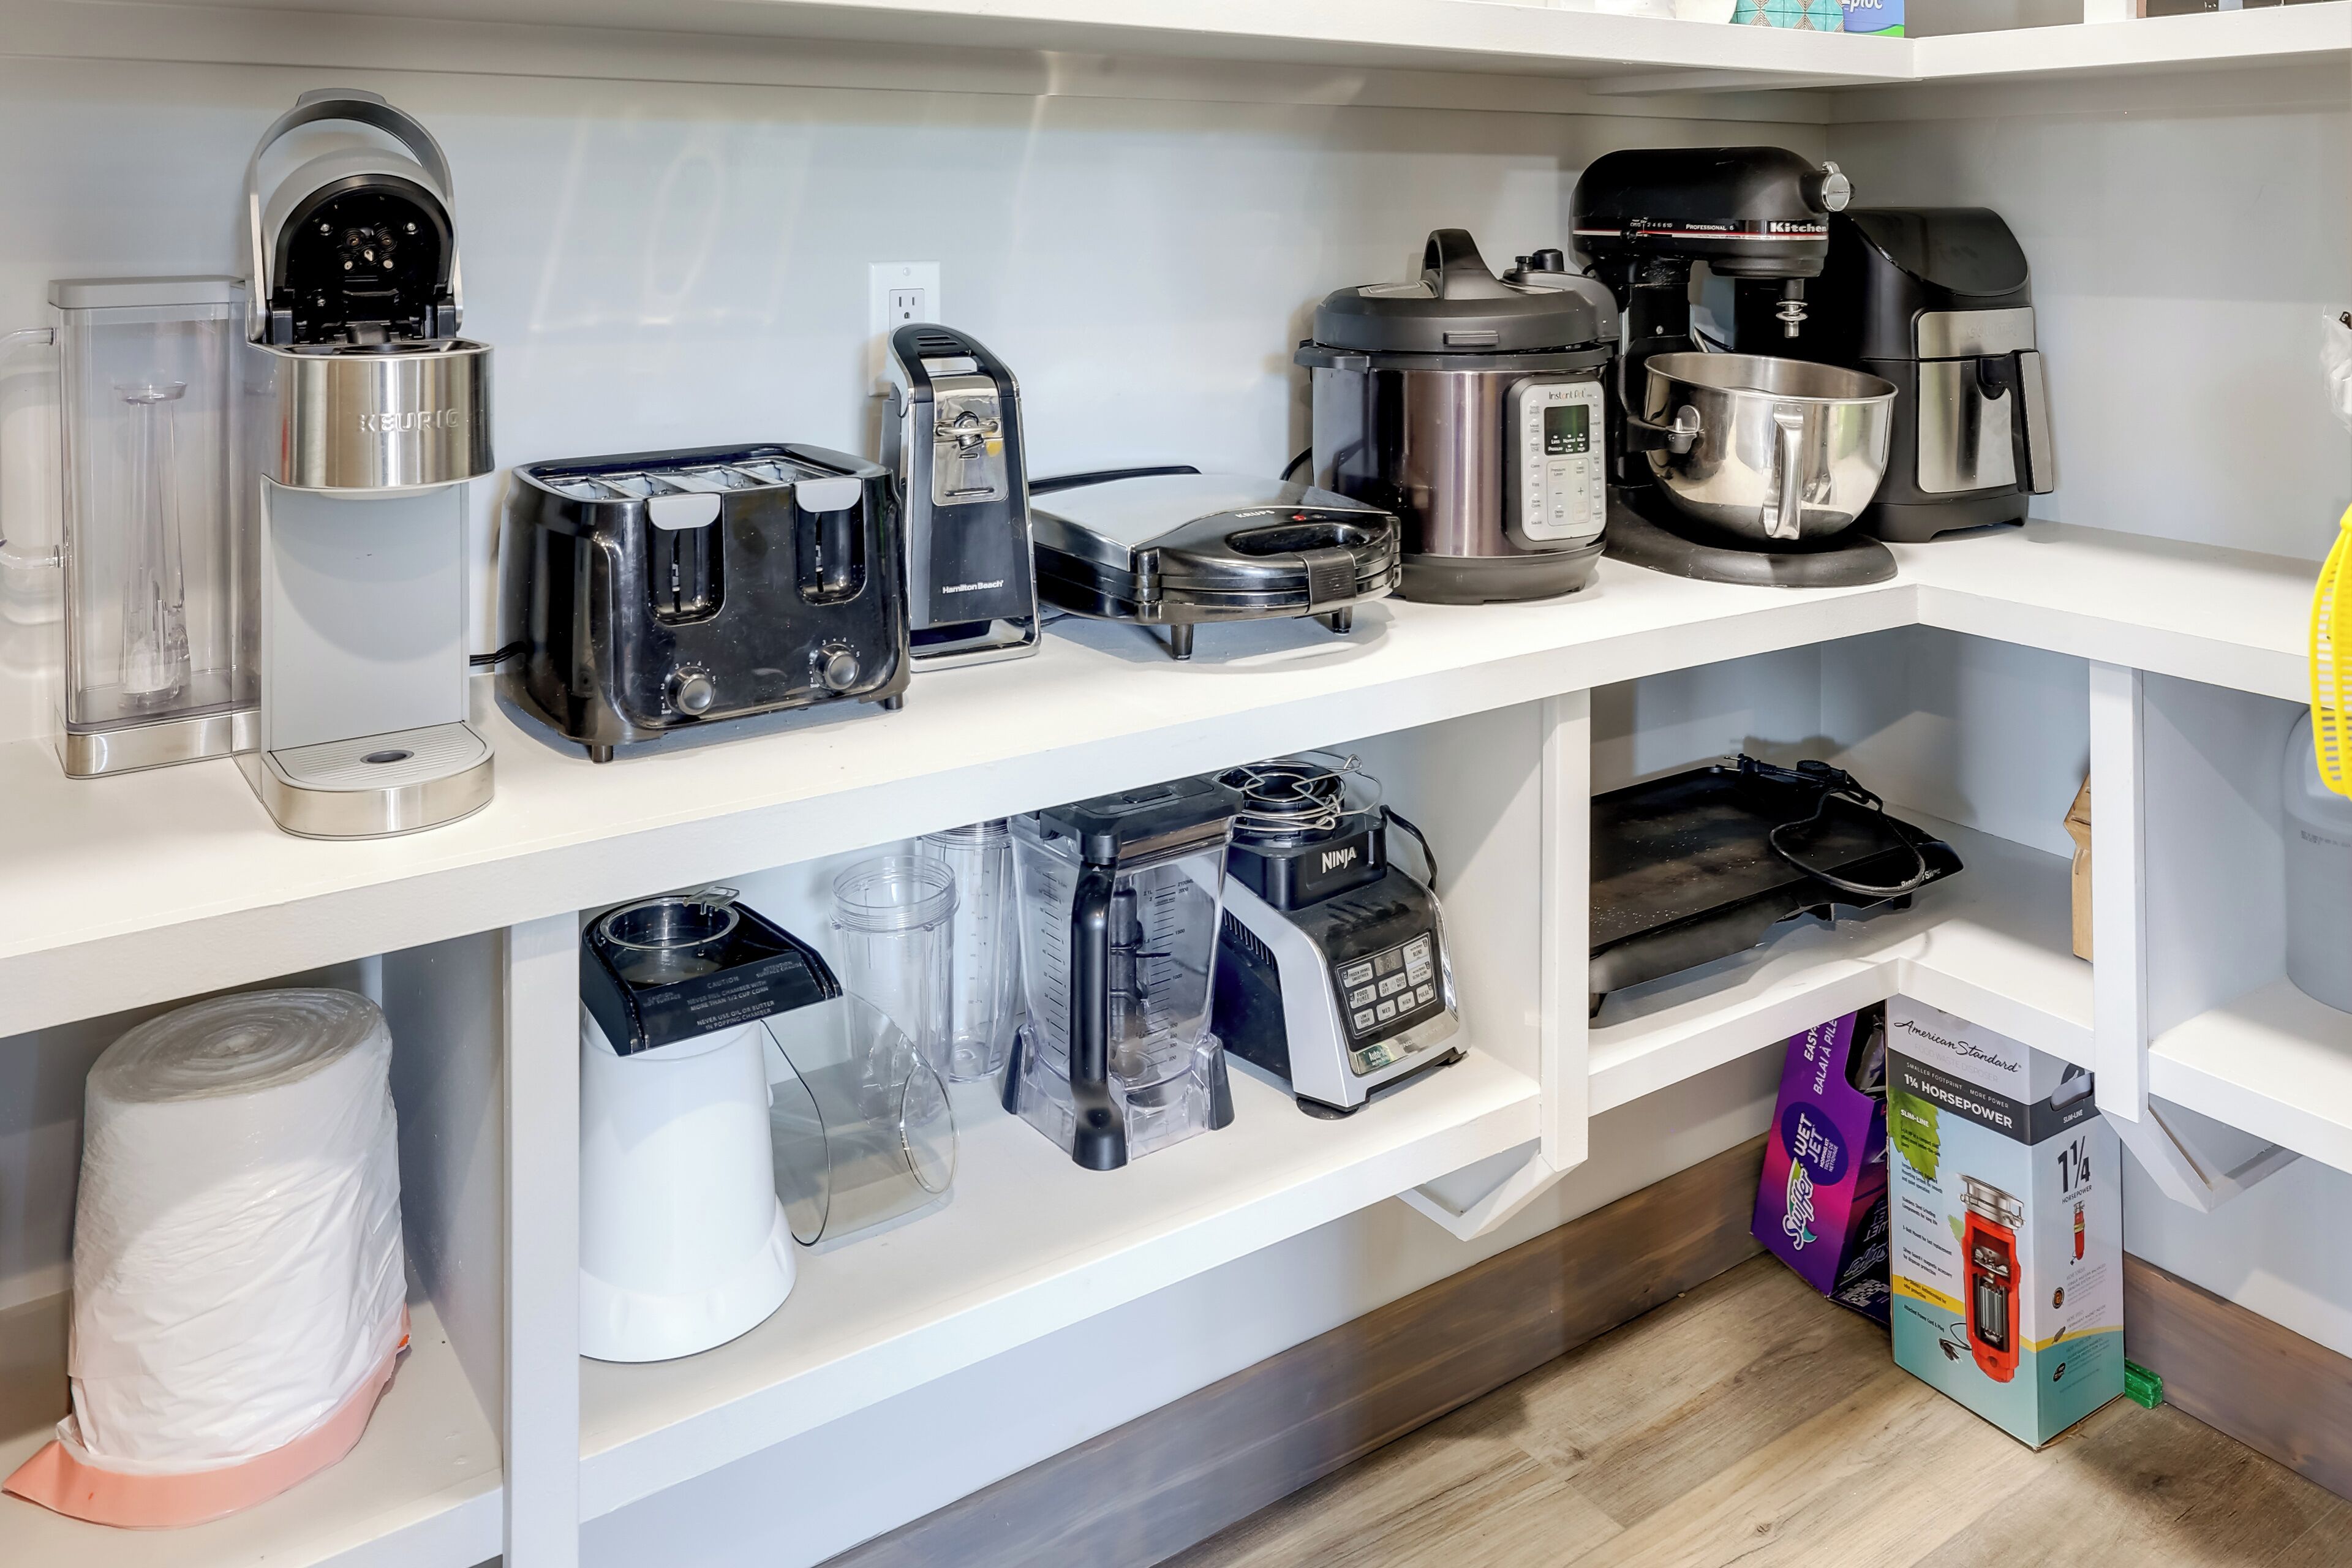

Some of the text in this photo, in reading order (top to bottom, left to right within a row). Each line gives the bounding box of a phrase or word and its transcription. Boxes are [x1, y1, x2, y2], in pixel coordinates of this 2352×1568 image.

[360, 409, 459, 432] KEURIG
[1235, 510, 1275, 519] KRUPS
[942, 579, 1003, 594] Hamilton Beach
[1322, 846, 1357, 873] NINJA
[707, 976, 739, 989] CAUTION
[687, 996, 704, 1005] NEVER
[722, 986, 750, 997] CHAMBER
[709, 998, 727, 1007] THAN
[1357, 994, 1370, 1003] PUREE
[697, 1016, 717, 1026] NEVER
[752, 1000, 775, 1011] BUTTER
[714, 1017, 742, 1029] POPPING
[742, 1009, 771, 1021] CHAMBER
[1804, 1025, 1820, 1061] EASY-
[1819, 1046, 1831, 1058] À
[1894, 1020, 2019, 1073] American Standard
[1915, 1044, 1998, 1082] FOOD WASTE DISPOSER
[1813, 1056, 1828, 1095] BALAI
[1906, 1062, 1930, 1077] SMALLER
[1970, 1089, 1986, 1100] MORE
[1988, 1096, 2009, 1109] POWER
[1921, 1080, 2013, 1129] HORSEPOWER
[1901, 1109, 1929, 1127] SLIM-LINE
[2063, 1109, 2083, 1123] SLIM-LINE
[1793, 1112, 1813, 1156] WET
[1807, 1125, 1823, 1164] JET
[2062, 1185, 2092, 1205] HORSEPOWER
[1782, 1166, 1814, 1251] Swiffer
[1871, 1210, 1888, 1226] ET
[1932, 1242, 1952, 1256] replacement
[1920, 1264, 1936, 1276] protection
